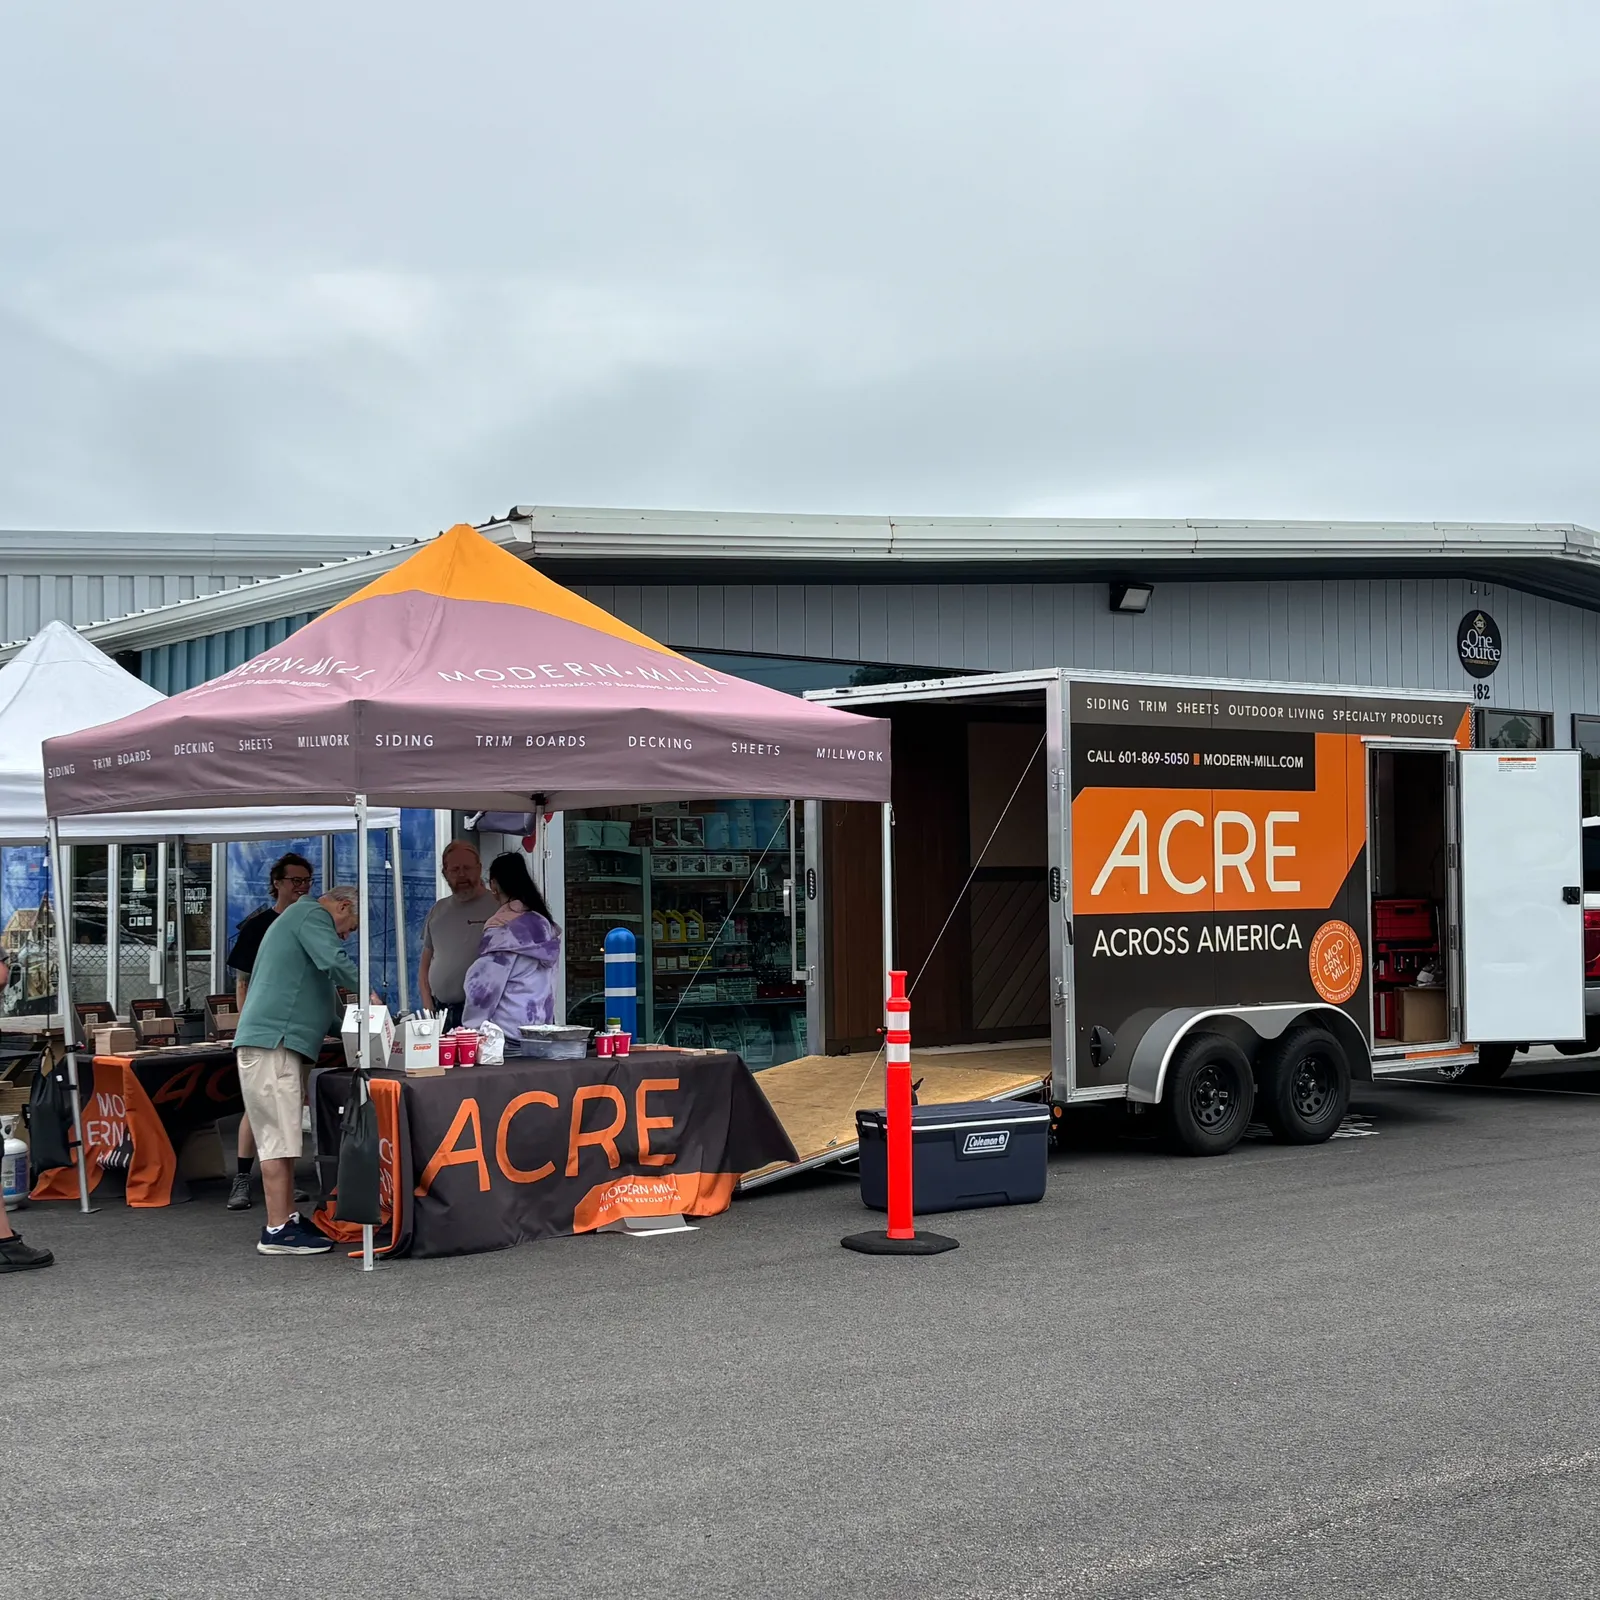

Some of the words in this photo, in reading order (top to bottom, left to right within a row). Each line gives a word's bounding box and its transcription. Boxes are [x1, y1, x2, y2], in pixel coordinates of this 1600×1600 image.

[1461, 639, 1501, 662] Source
[1467, 628, 1493, 649] One
[1473, 683, 1491, 700] 182
[1086, 697, 1129, 711] SIDING
[1138, 700, 1167, 713] TRIM
[1176, 701, 1219, 715] SHEETS
[1228, 704, 1284, 718] OUTDOOR
[1288, 707, 1324, 720] LIVING
[1332, 709, 1387, 723] SPECIALTY
[1390, 712, 1443, 726] PRODUCTS
[48, 763, 76, 779] SIDING
[92, 757, 112, 770] TRIM
[117, 749, 152, 765] BOARDS
[174, 741, 215, 755] DECKING
[238, 738, 273, 751] SHEETS
[298, 734, 350, 748] MILLWORK
[375, 734, 434, 747] SIDING
[475, 735, 513, 747] TRIM
[525, 735, 586, 747] BOARDS
[628, 735, 693, 750] DECKING
[731, 742, 780, 756] SHEETS
[816, 747, 883, 762] MILLWORK
[1087, 749, 1116, 763] CALL
[1118, 750, 1190, 765] 601-869-5050
[1203, 752, 1304, 769] MODERN-MILL.COM
[1090, 809, 1301, 896] ACRE
[1092, 926, 1190, 957] ACROSS
[1197, 923, 1303, 953] AMERICA
[1323, 939, 1344, 962] MOD
[1331, 961, 1350, 982] MILL
[96, 1091, 126, 1118] MO
[414, 1078, 680, 1197] ACRE
[969, 1135, 999, 1148] Coleman
